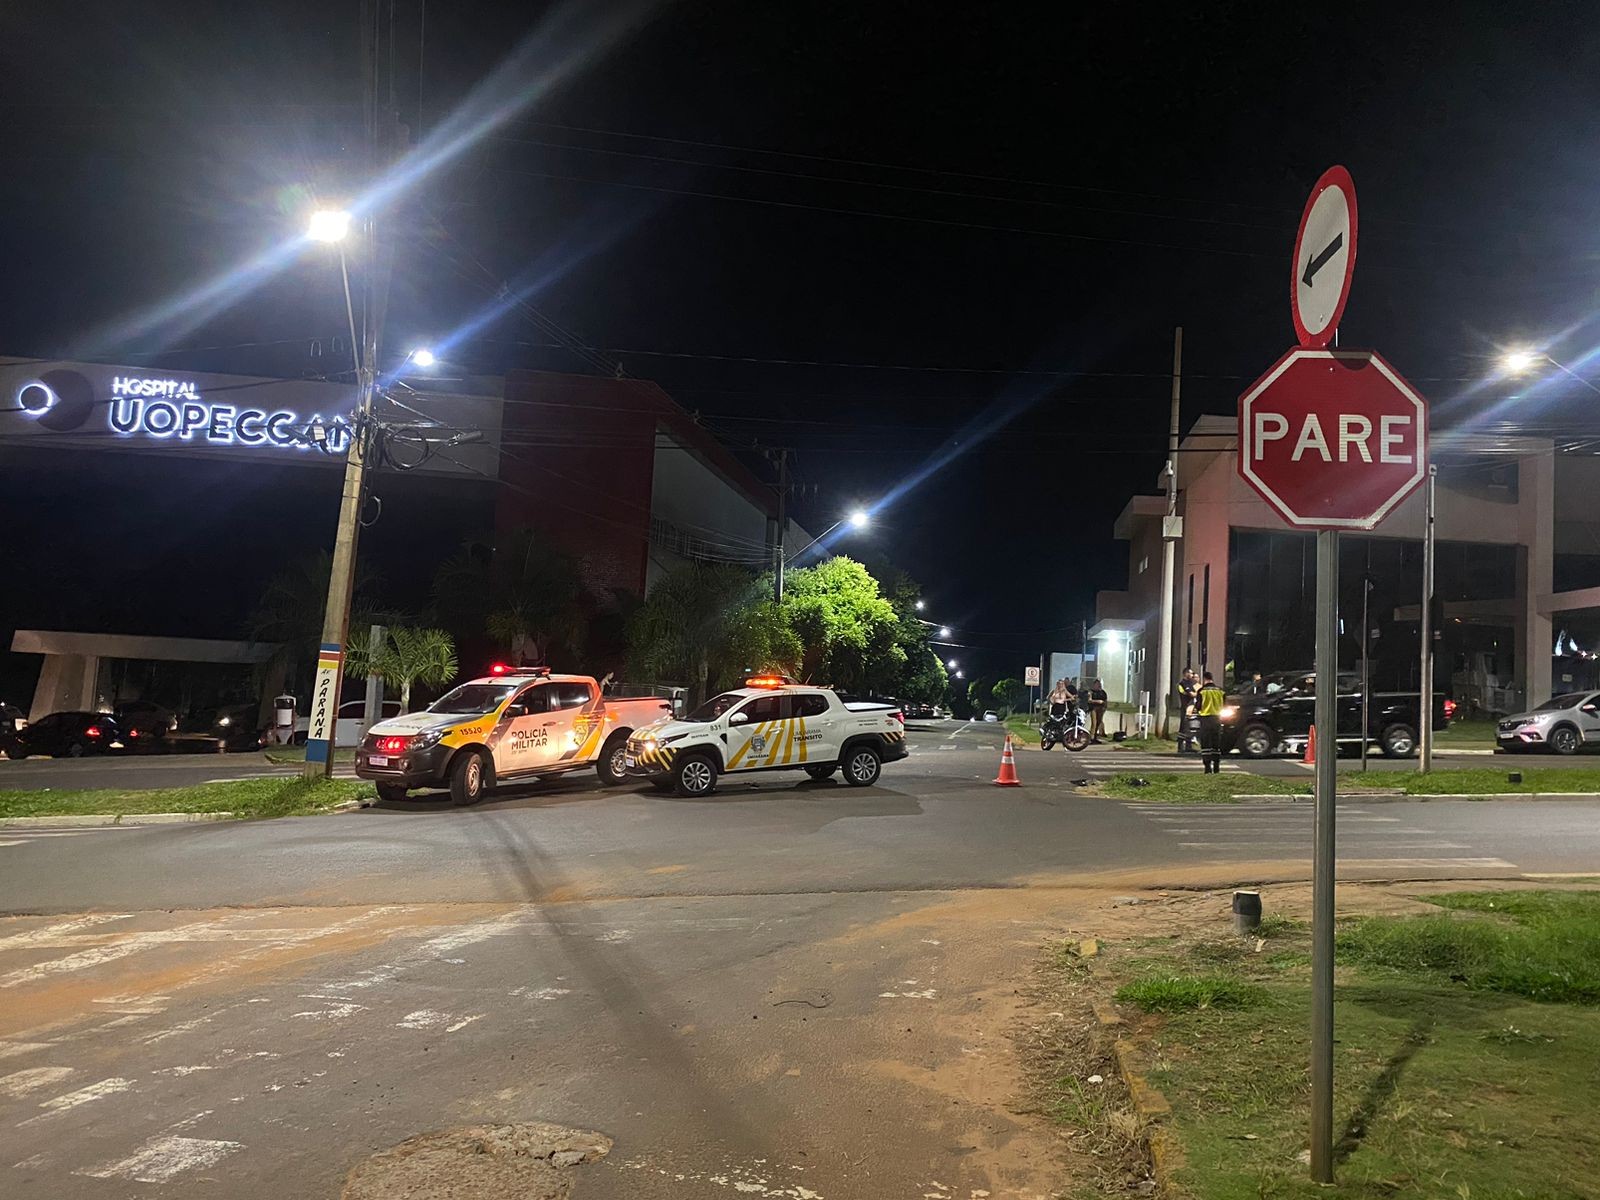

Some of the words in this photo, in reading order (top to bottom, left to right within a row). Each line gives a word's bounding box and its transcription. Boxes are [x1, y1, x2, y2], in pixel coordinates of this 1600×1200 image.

[112, 377, 201, 400] HOSPITAL
[1255, 412, 1413, 464] PARE
[459, 726, 482, 736] 15520
[511, 738, 548, 750] MILITAR
